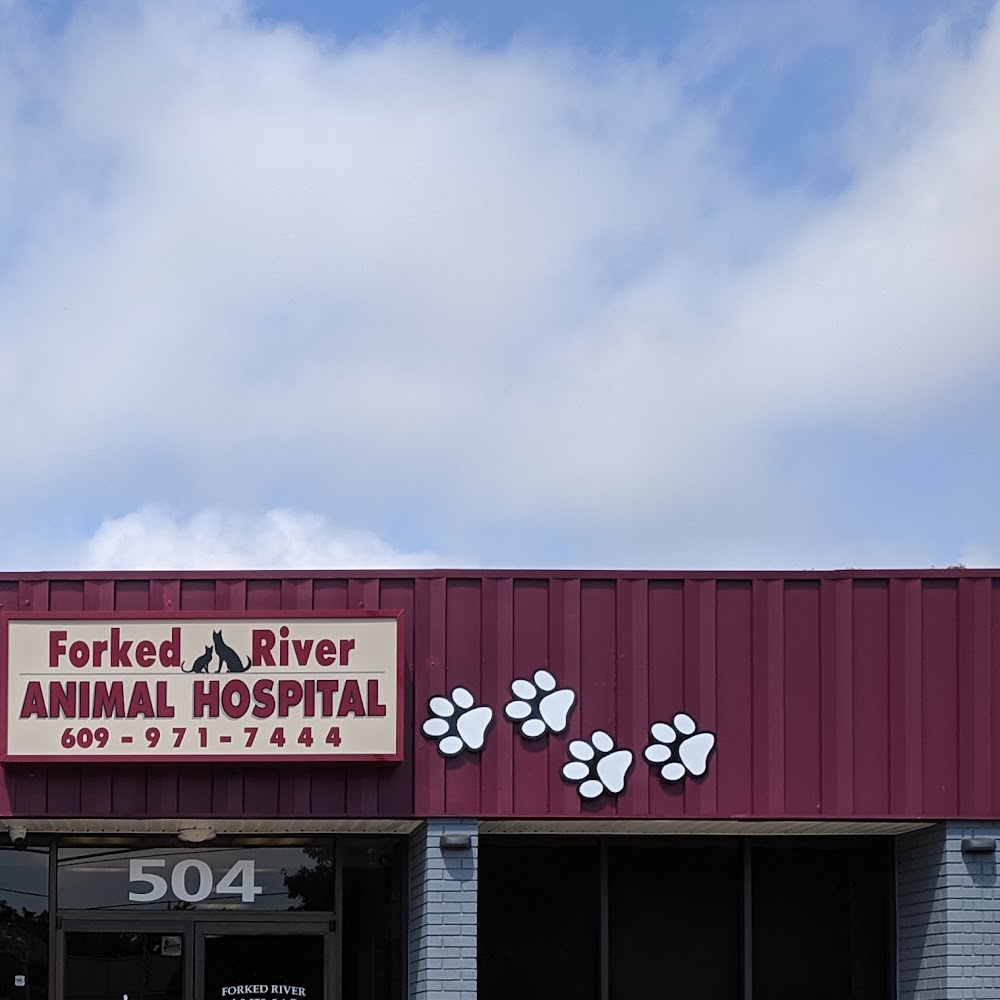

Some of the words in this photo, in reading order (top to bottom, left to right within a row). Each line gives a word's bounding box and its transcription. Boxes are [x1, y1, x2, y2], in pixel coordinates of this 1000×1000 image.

[48, 626, 181, 668] Forked
[252, 625, 355, 667] River
[19, 680, 175, 719] ANIMAL
[191, 678, 387, 719] HOSPITAL
[128, 859, 263, 903] 504
[221, 985, 268, 996] FORKED
[271, 985, 306, 997] RIVER
